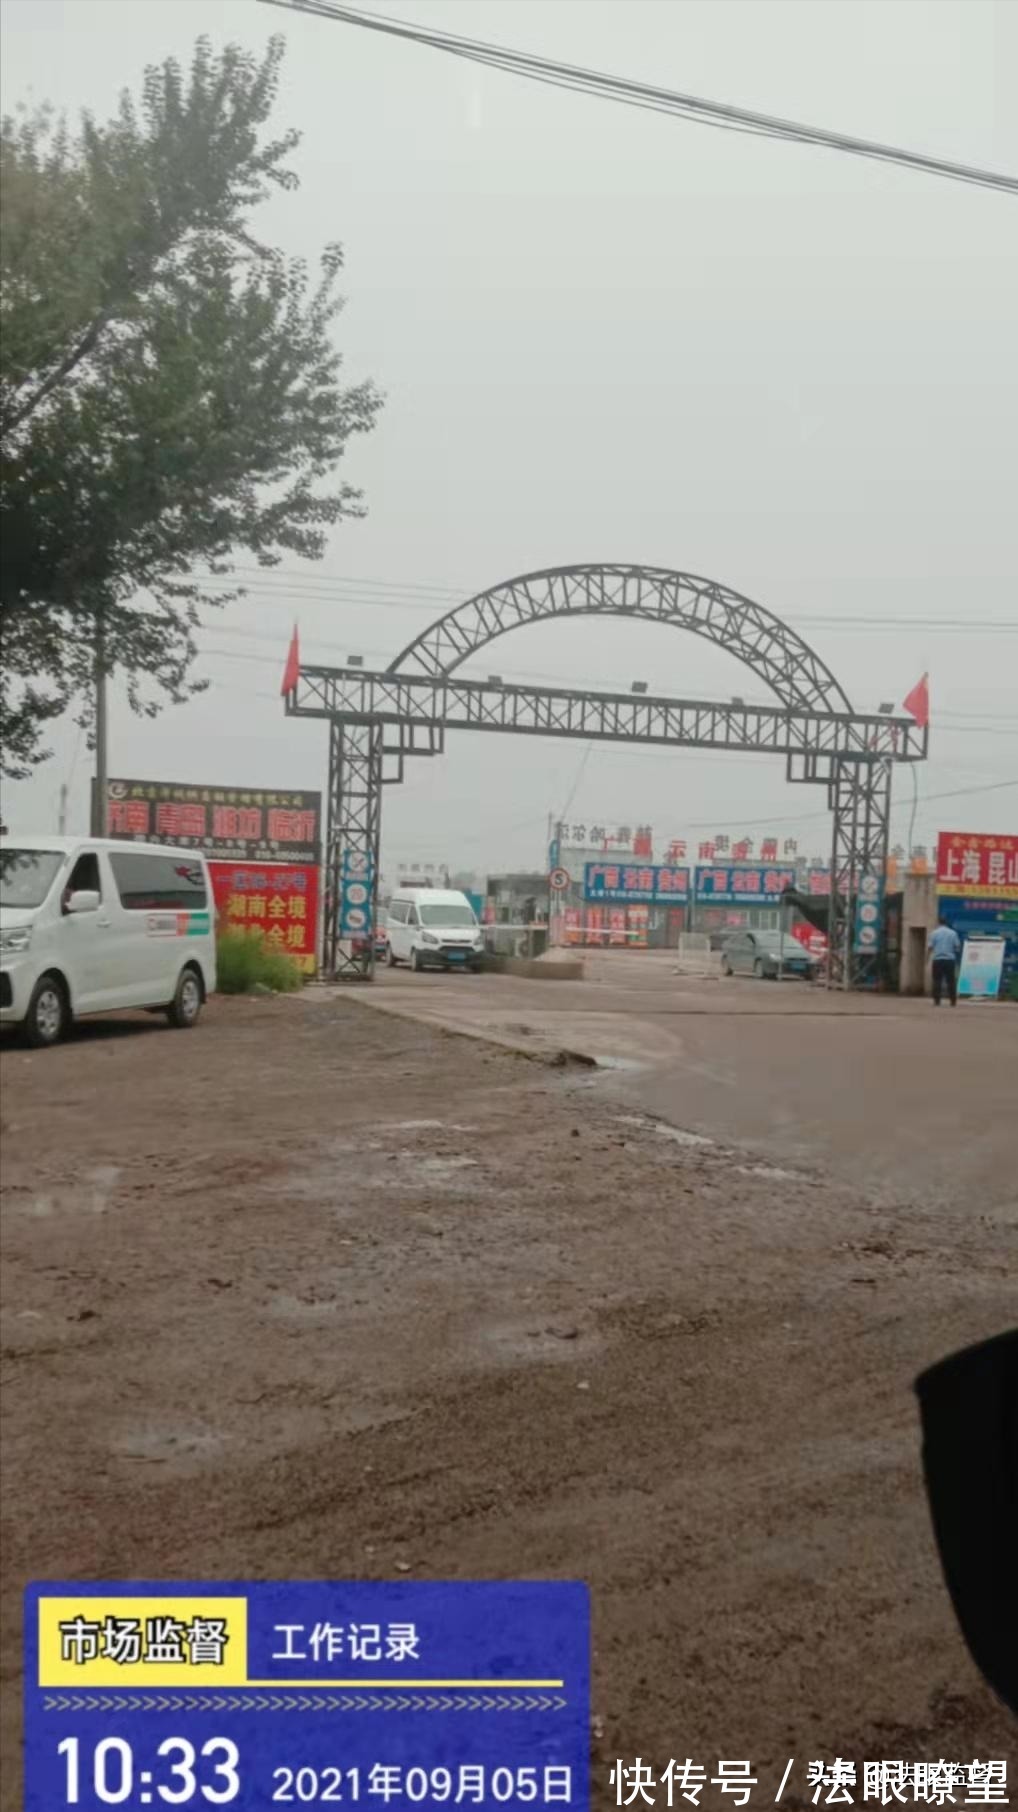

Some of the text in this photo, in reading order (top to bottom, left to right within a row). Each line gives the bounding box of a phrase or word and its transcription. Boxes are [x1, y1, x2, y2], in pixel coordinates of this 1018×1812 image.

[156, 802, 206, 838] 青岛
[939, 847, 982, 884] 上海
[226, 893, 307, 919] 湖南全境
